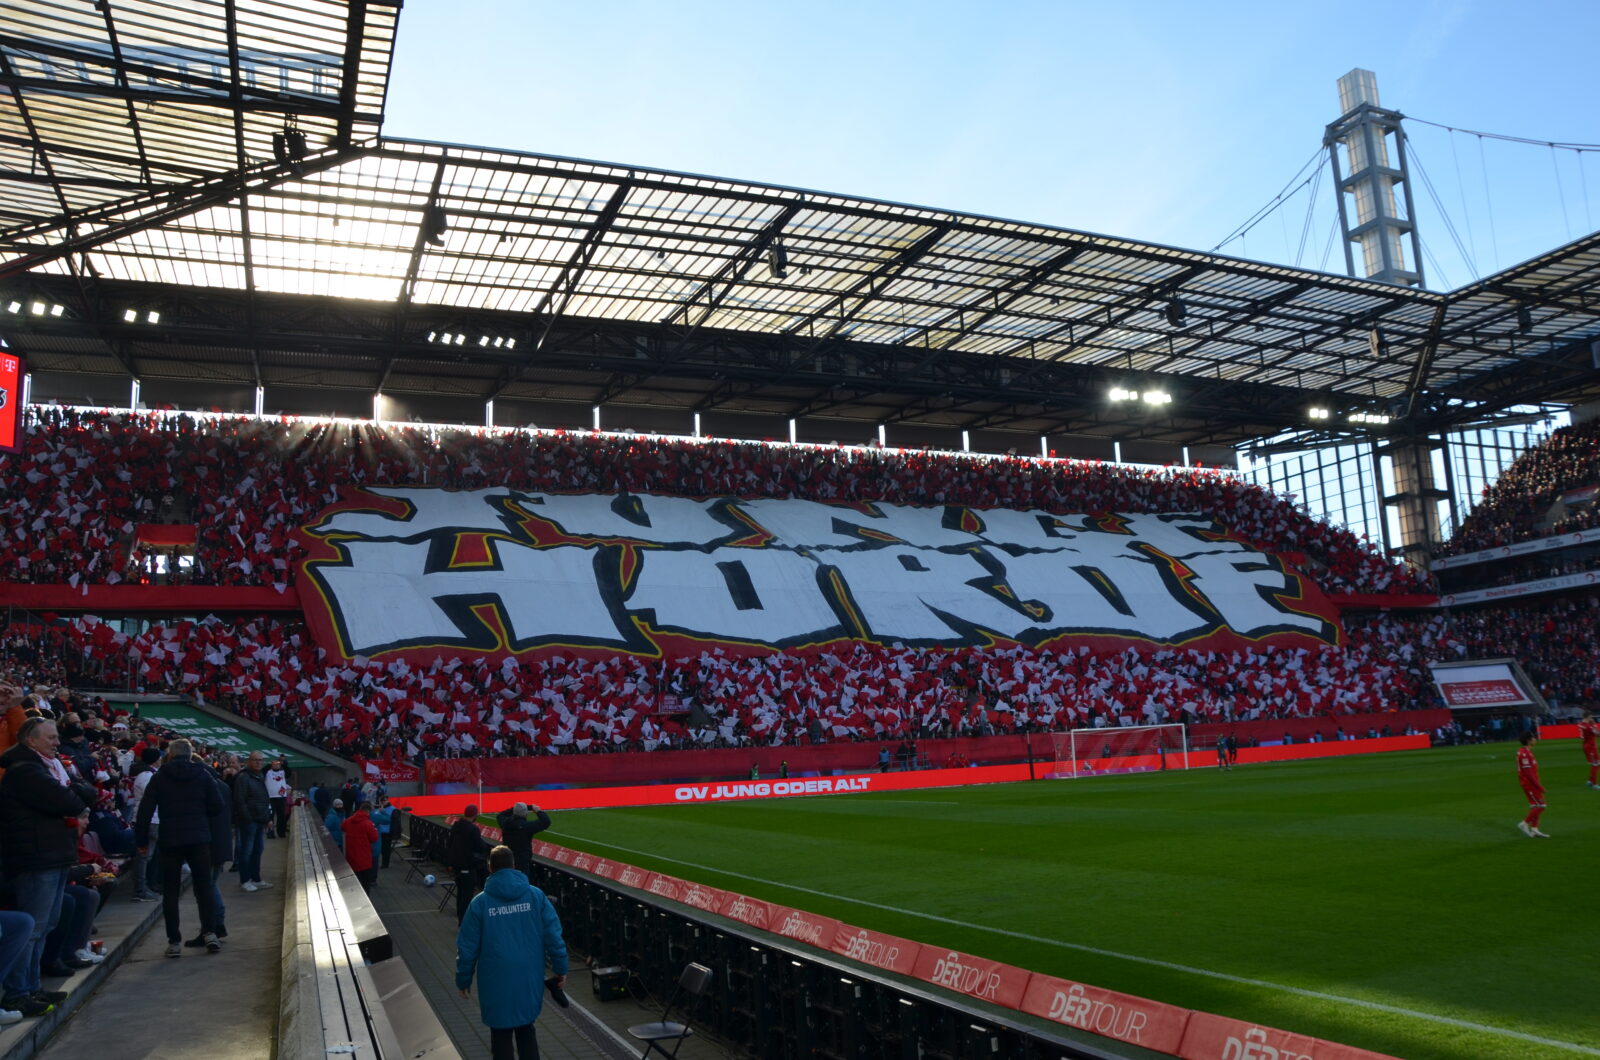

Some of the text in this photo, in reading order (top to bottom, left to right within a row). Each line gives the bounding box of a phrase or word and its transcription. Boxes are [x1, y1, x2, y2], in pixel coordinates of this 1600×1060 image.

[308, 487, 1252, 553] JUNGE
[308, 537, 1335, 657] HORDE
[675, 777, 871, 800] OV JUNG ODER ALT
[488, 902, 531, 917] FC-VOLUNTEER
[728, 901, 764, 925] DERTOUR
[780, 917, 823, 944] DERTOUR
[845, 935, 899, 969] DERTOUR
[932, 957, 1000, 1000] DERTOUR
[1048, 989, 1149, 1043] DERTOUR
